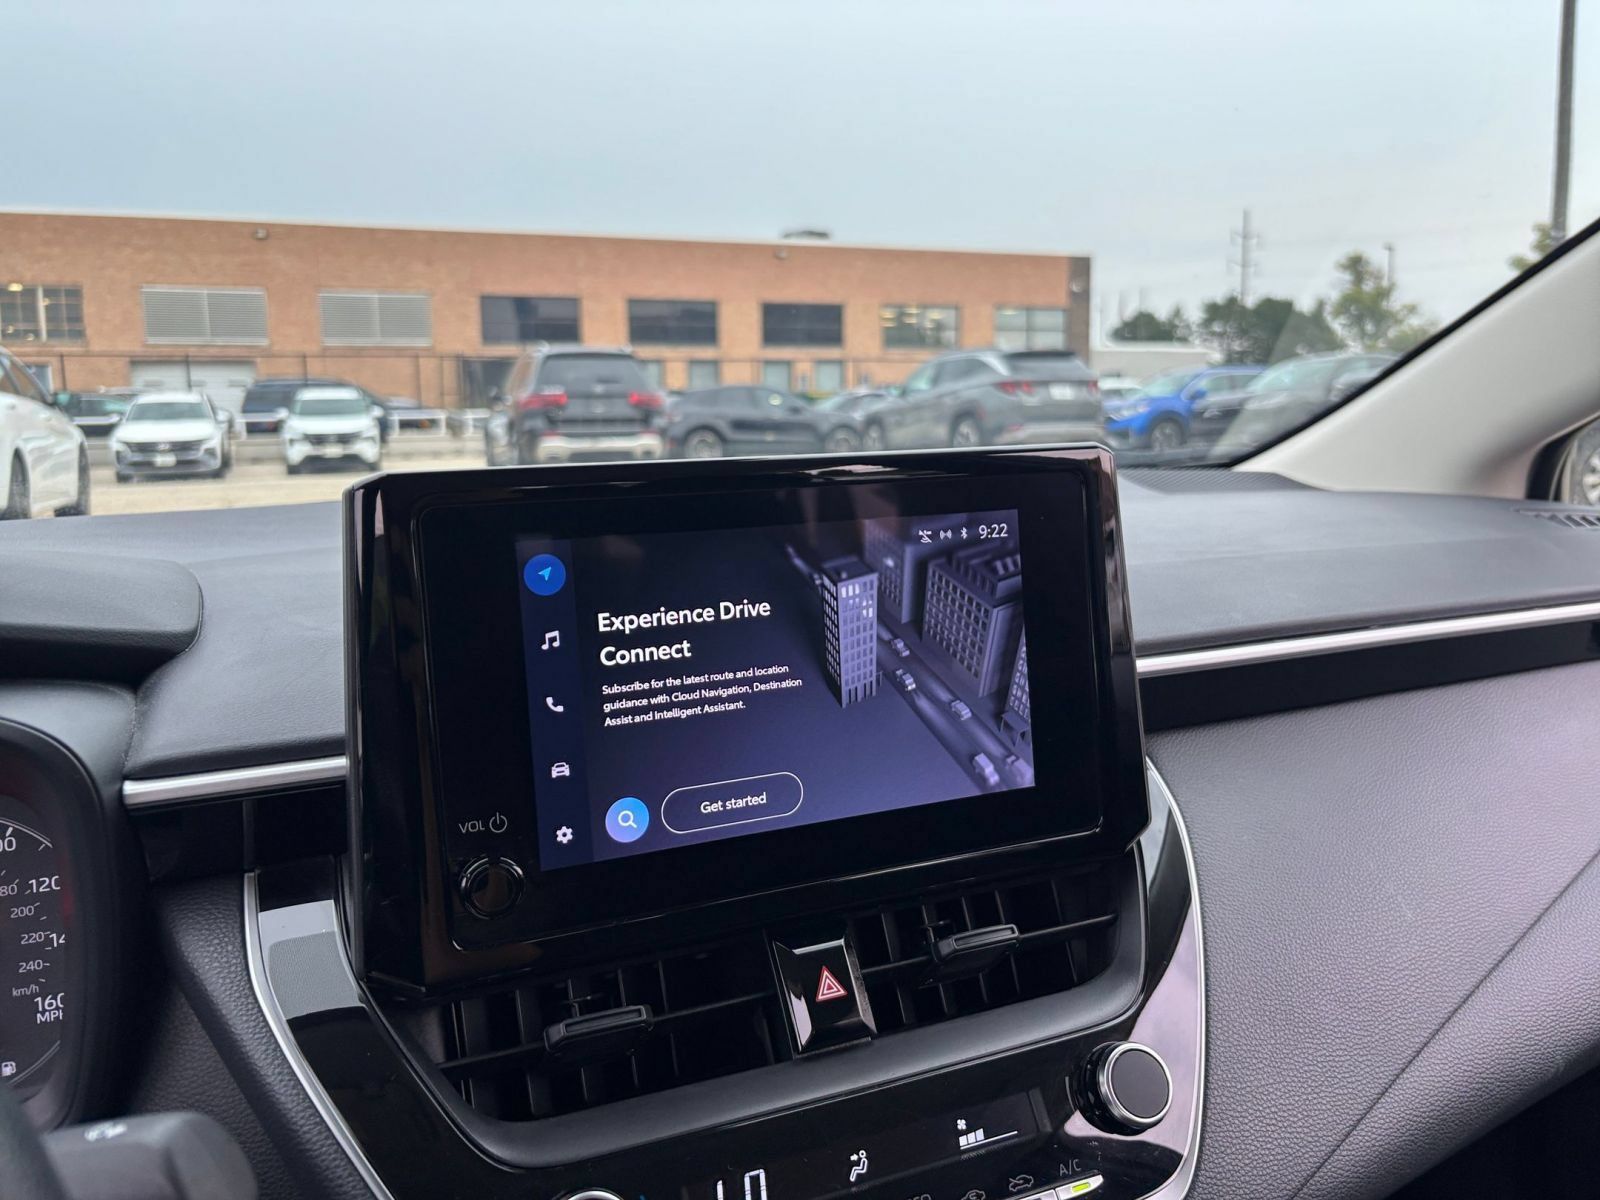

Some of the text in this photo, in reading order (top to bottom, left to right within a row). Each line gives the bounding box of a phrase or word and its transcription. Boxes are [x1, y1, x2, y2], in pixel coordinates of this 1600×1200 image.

[978, 523, 1008, 539] 9:22
[597, 599, 771, 634] Experience Drive
[600, 640, 692, 666] Connect
[602, 664, 789, 695] Subscribe for the latest route and location
[603, 678, 802, 713] guidance with Cloud Navigation, Destination
[604, 700, 746, 727] Assist and Intelligent Assistant.
[700, 791, 767, 813] Get started
[458, 819, 486, 834] VOL
[10, 905, 35, 918] 200
[20, 931, 45, 944] 220
[18, 959, 43, 973] 240
[12, 984, 40, 997] km/h
[1059, 1159, 1082, 1177] A/C
